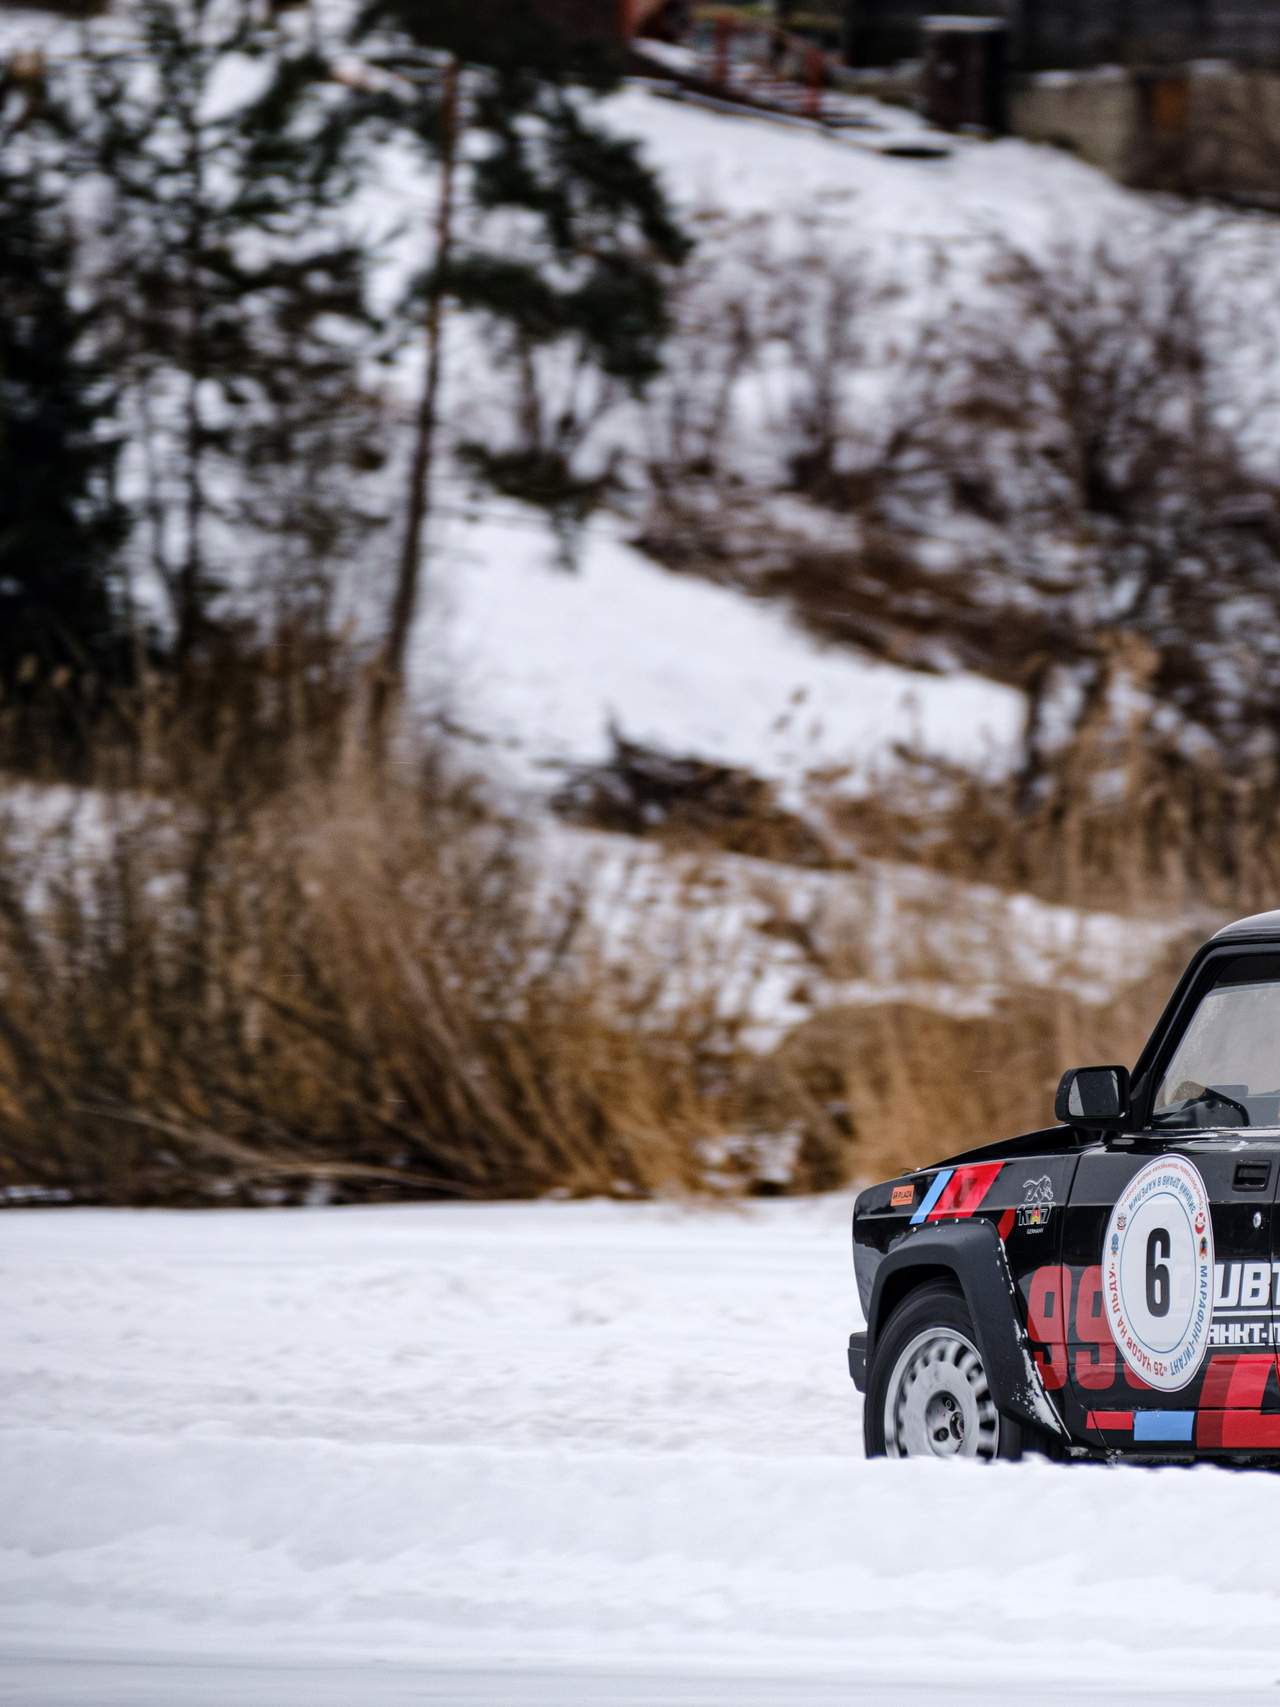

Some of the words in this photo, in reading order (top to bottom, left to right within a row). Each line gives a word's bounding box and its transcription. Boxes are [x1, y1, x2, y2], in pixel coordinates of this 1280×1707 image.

[1128, 1179, 1156, 1211] КАРЕЛИИ
[1162, 1175, 1181, 1188] ДРАЙВ
[1179, 1182, 1197, 1214] ЗИМНИЙ
[1146, 1228, 1170, 1317] 6
[1027, 1265, 1154, 1390] 99
[1117, 1316, 1128, 1339] НА
[1169, 1265, 1208, 1376] МАРАФОН-ГИГАНТ
[1126, 1337, 1152, 1372] ЧАСОВ
